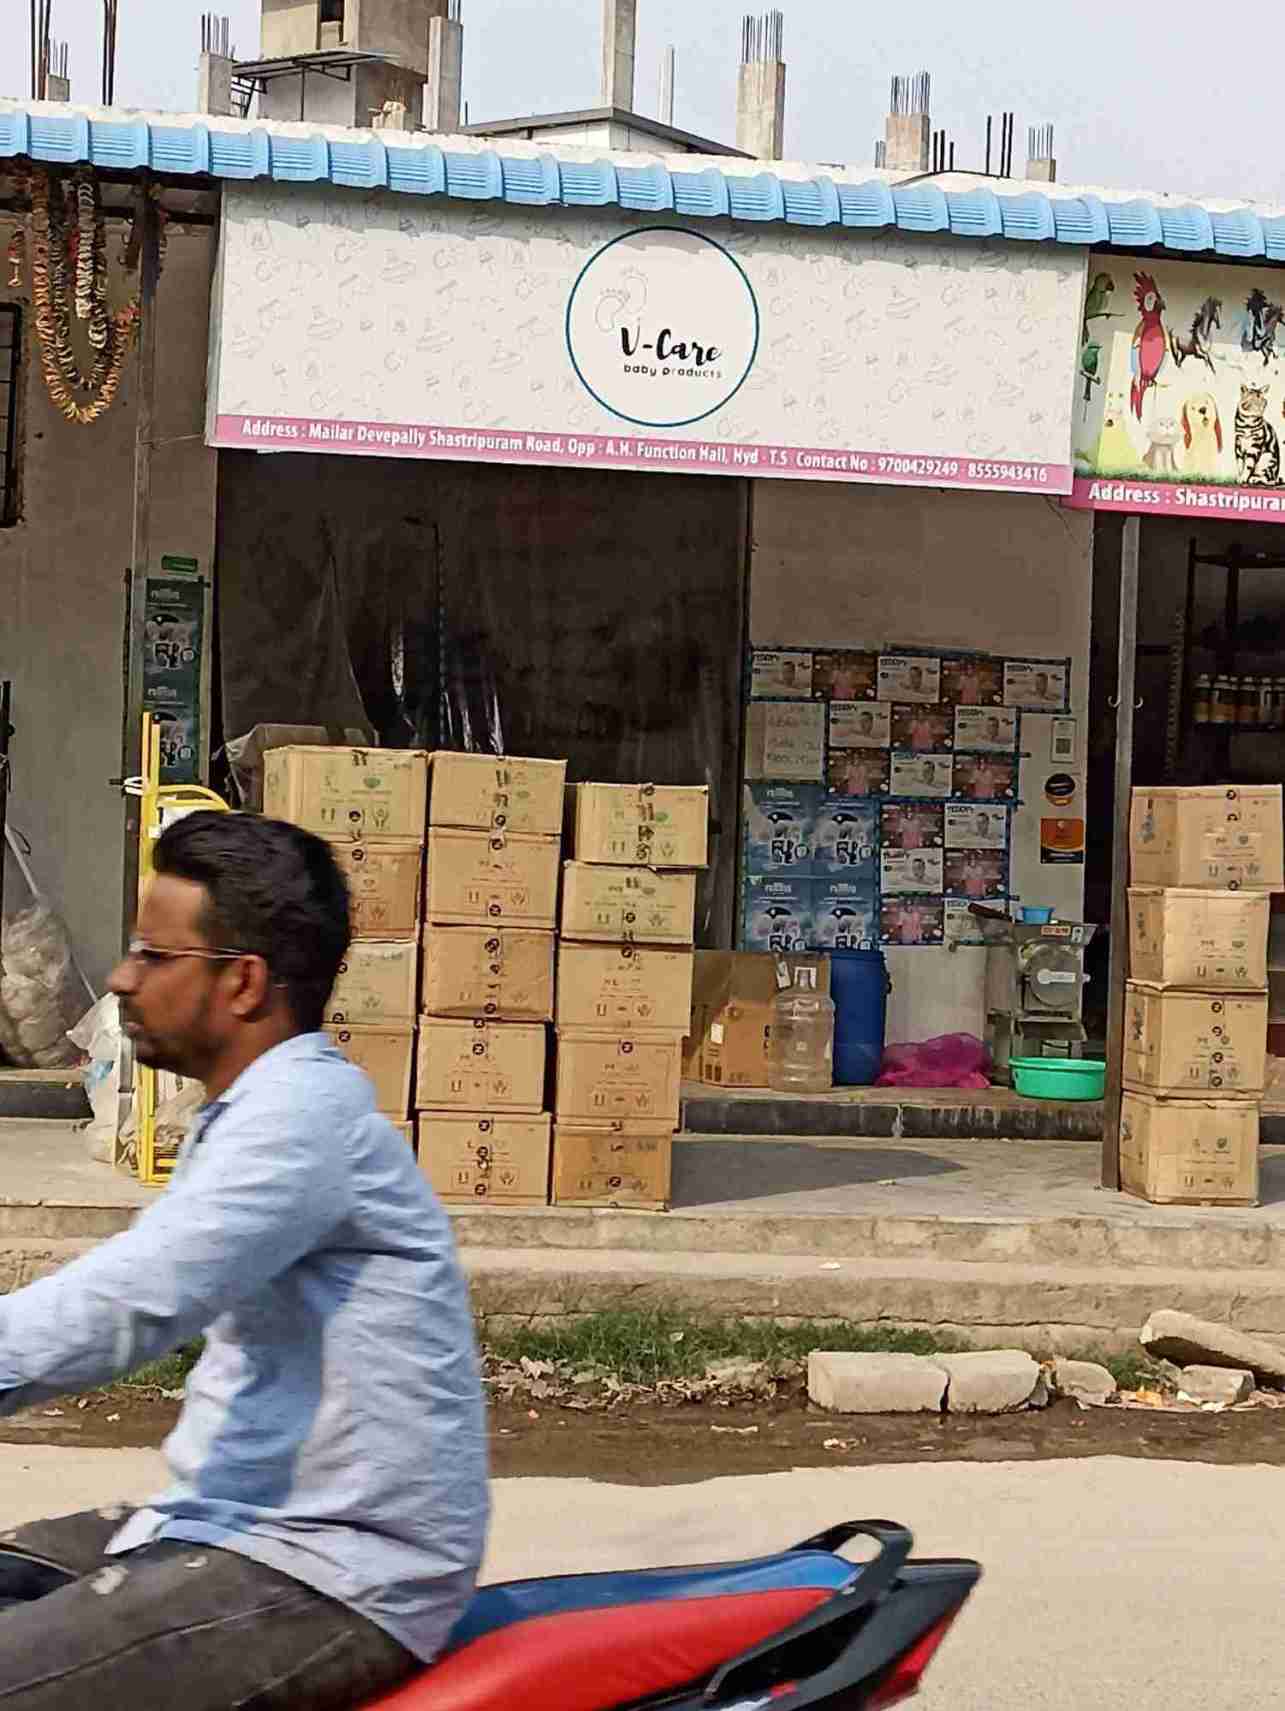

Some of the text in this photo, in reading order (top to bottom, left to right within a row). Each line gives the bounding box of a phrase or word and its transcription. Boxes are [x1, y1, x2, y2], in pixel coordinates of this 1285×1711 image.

[621, 317, 721, 366] V-Care
[623, 364, 721, 378] baby products
[242, 419, 298, 438] Address
[357, 425, 426, 448] Devepally
[429, 430, 523, 451] Shastripuram
[637, 442, 696, 460] Function
[732, 446, 758, 466] Hyd
[796, 451, 848, 469] Contact
[877, 456, 958, 477] 9700429249
[967, 462, 1048, 482] 8555943416
[1088, 482, 1160, 504] Address
